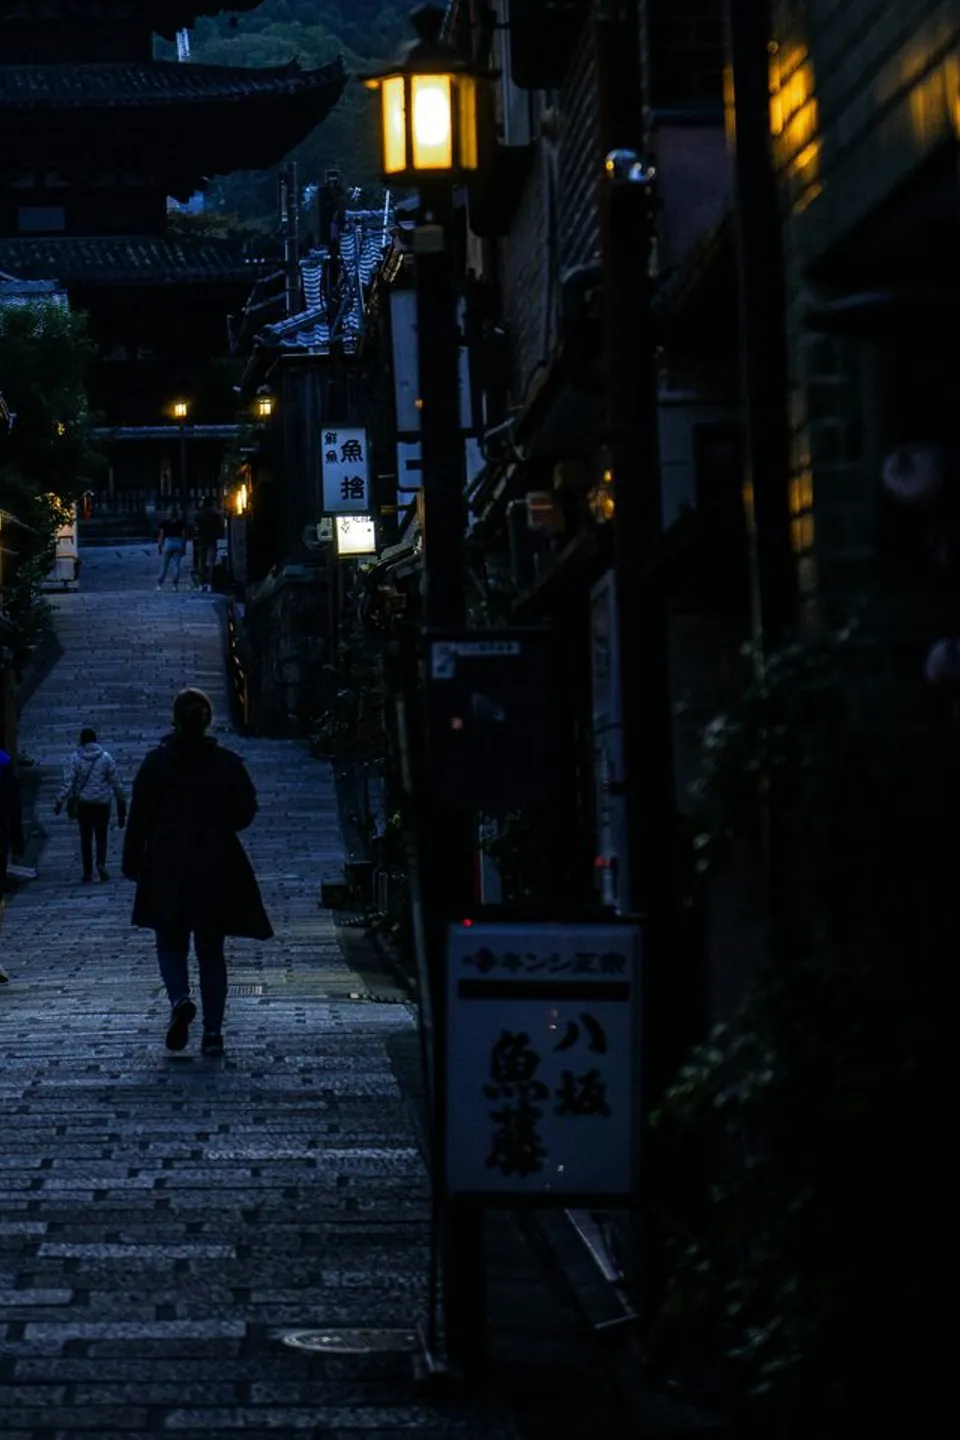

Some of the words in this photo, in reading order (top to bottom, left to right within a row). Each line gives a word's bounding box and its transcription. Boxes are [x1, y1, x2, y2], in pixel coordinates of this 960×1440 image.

[324, 432, 339, 464] 鮮魚
[340, 438, 365, 500] 魚捨
[483, 1029, 550, 1178] 魚藤
[553, 1013, 612, 1118] 八坂
